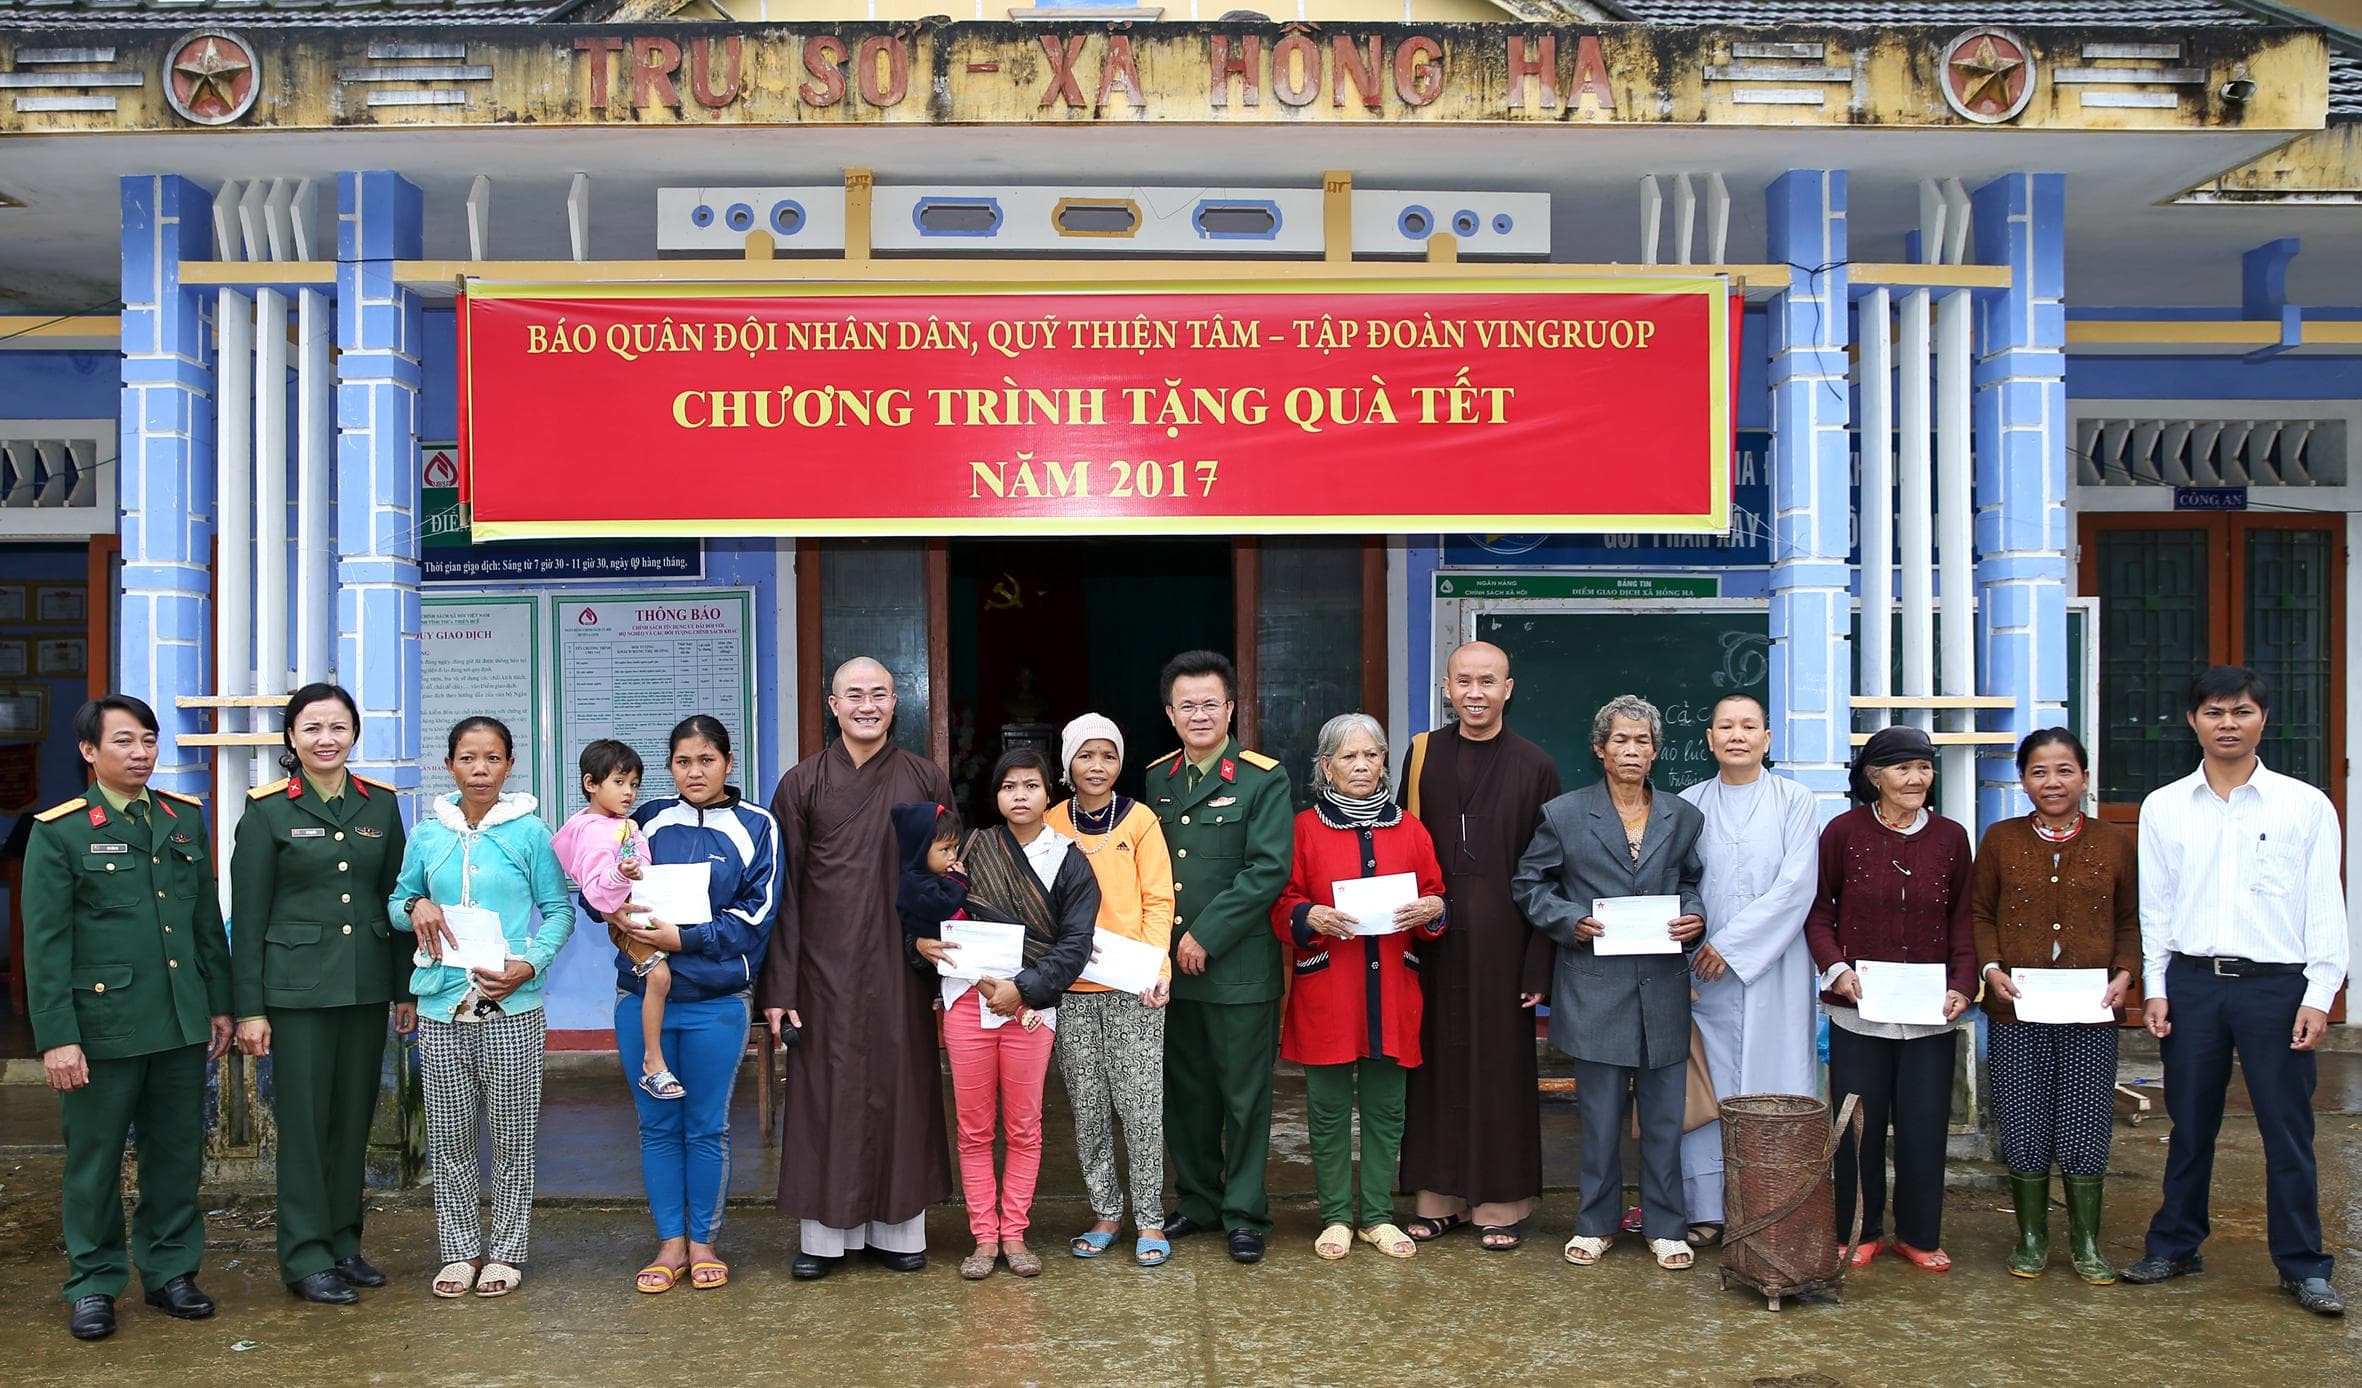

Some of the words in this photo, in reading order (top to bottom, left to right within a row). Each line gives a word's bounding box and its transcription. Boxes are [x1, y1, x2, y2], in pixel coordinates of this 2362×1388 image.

[575, 36, 741, 119] TRỤ
[800, 22, 921, 107] SỞ
[966, 63, 999, 73] -
[1039, 20, 1147, 107] XÃ
[1211, 22, 1444, 107] HỒNG
[1507, 35, 1616, 119] HẠ
[527, 317, 597, 353] BÁO
[606, 316, 706, 361] QUÂN
[713, 315, 777, 358] ĐỘI
[786, 315, 889, 350] NHÂN
[896, 315, 979, 356] DÂN,
[988, 314, 1061, 358] QUỸ
[1068, 313, 1178, 356] THIỆN
[1186, 313, 1261, 349] TÂM
[1293, 313, 1359, 355] TẬP
[1367, 312, 1466, 349] ĐOÀN
[1473, 319, 1655, 350] VINGRUOP
[672, 385, 914, 428] CHƯƠNG
[928, 376, 1107, 426] TRÌNH
[1122, 377, 1269, 438] TẶNG
[1284, 374, 1399, 433] QUÀ
[1411, 366, 1514, 424] TẾT
[968, 450, 1092, 498] NĂM
[1108, 460, 1219, 498] 2017
[2180, 491, 2219, 505] CÔNG
[2223, 494, 2242, 505] AN
[431, 508, 471, 533] ĐIỂ
[424, 560, 443, 573] Thời
[445, 560, 461, 574] gian
[502, 559, 521, 572] Sáng
[534, 559, 539, 570] 7
[541, 558, 554, 572] giờ
[554, 558, 564, 569] 30
[572, 558, 580, 569] 11
[582, 557, 595, 571] giờ
[596, 557, 609, 570] 30,
[642, 556, 661, 570] hàng
[663, 556, 688, 569] tháng.
[1639, 579, 1652, 587] TIN
[635, 606, 687, 622] THÔNG
[691, 604, 721, 621] BÁO
[436, 630, 464, 640] GIAO
